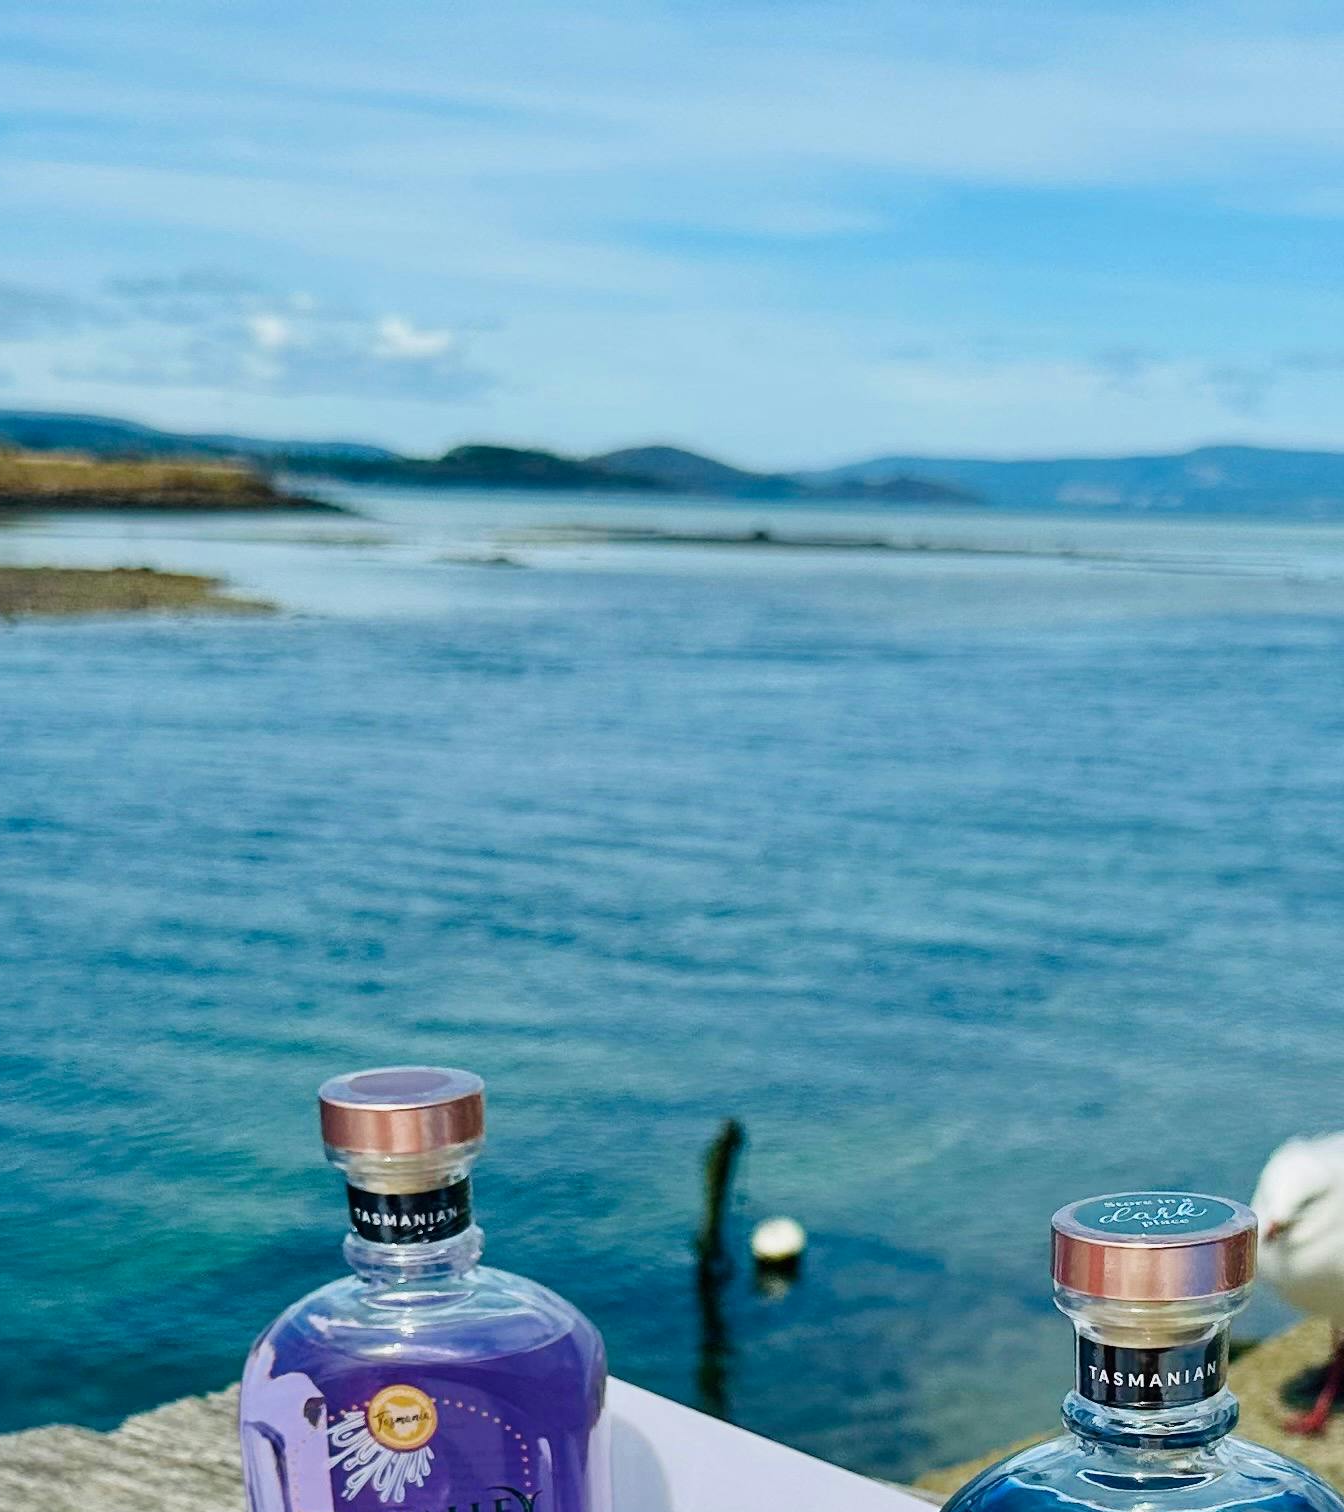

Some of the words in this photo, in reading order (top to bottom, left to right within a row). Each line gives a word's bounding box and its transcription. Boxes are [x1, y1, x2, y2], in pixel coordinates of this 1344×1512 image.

[354, 1205, 457, 1227] TASMANIAN
[1099, 1203, 1207, 1224] dark
[1088, 1360, 1216, 1388] TASMANIAN
